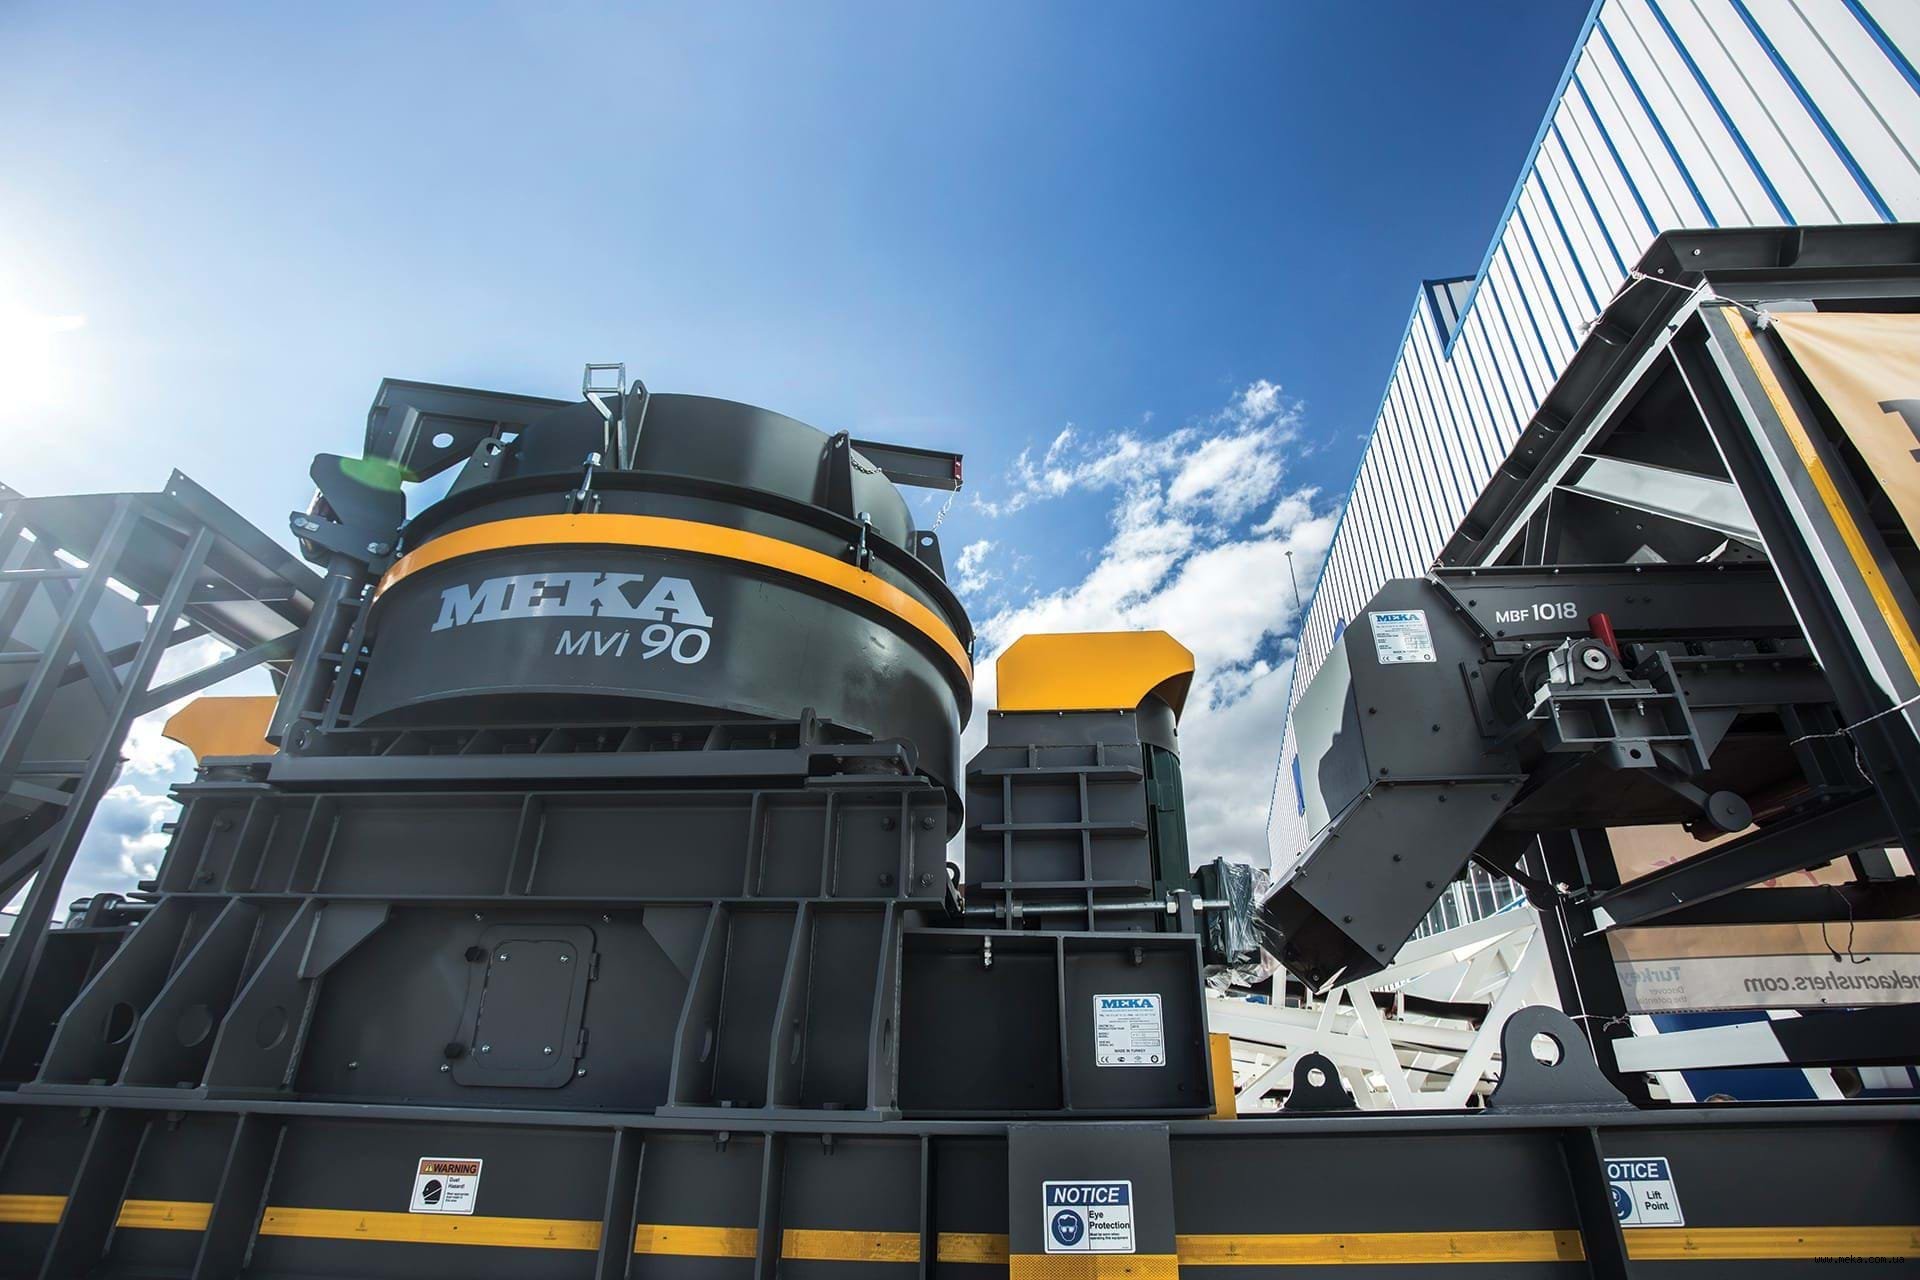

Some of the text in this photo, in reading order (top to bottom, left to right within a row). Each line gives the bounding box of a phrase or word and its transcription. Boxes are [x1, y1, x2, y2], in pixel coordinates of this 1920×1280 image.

[430, 572, 714, 633] MEKA
[1495, 602, 1578, 623] MBF 1018
[1375, 614, 1420, 622] MEKA
[640, 623, 711, 665] 90
[1101, 999, 1154, 1009] MEKA
[433, 1163, 477, 1174] WARNING
[1607, 1163, 1660, 1179] OTICE
[1053, 1187, 1120, 1203] NOTICE
[1646, 1190, 1662, 1200] Lift
[1644, 1201, 1670, 1211] Point
[1089, 1210, 1104, 1220] Eye
[1089, 1221, 1130, 1230] Protection
